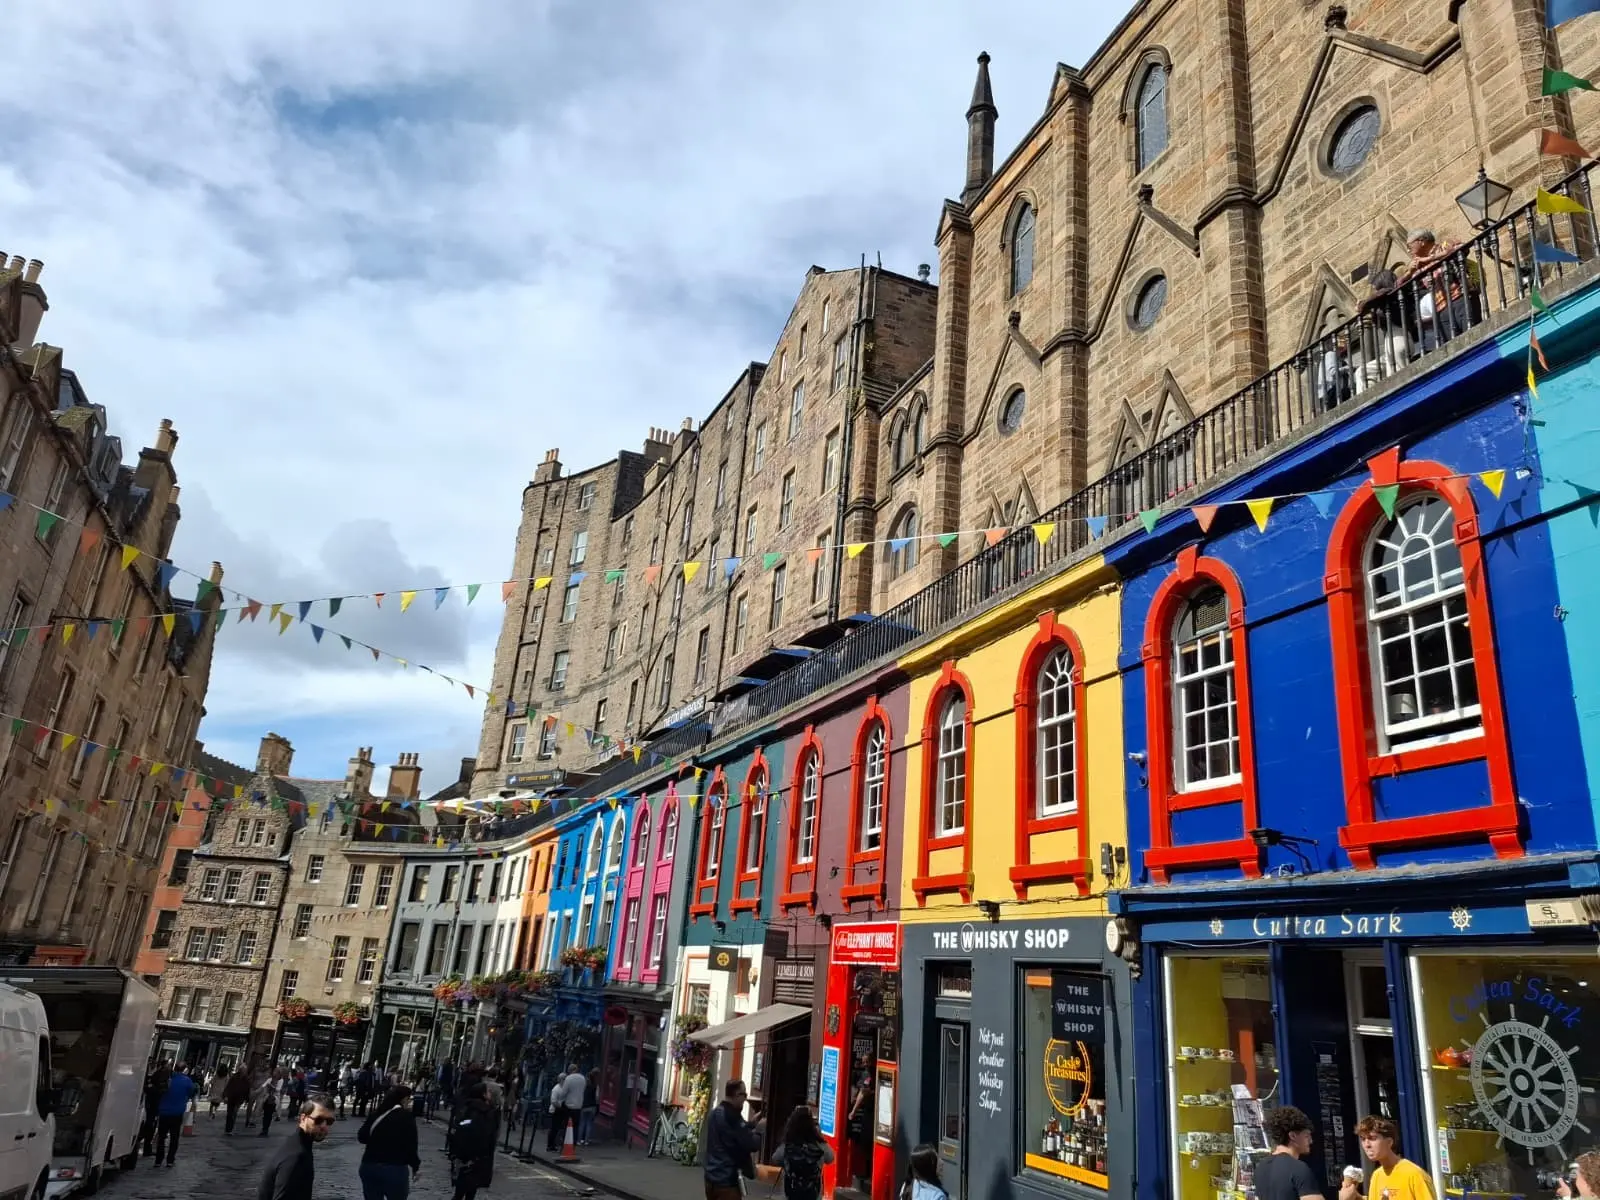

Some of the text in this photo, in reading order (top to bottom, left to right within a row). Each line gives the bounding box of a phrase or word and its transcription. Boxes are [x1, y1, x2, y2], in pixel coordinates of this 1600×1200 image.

[1253, 907, 1402, 936] Cuttea Sark
[847, 932, 875, 949] ELEPHANT
[875, 932, 895, 949] HOUSE
[933, 926, 1069, 951] THE WHISKY SHOP
[803, 965, 814, 977] SON
[1067, 985, 1089, 996] THE
[1056, 1001, 1102, 1016] WHISKY
[1524, 977, 1583, 1029] Sark
[1064, 1022, 1094, 1033] SHOP
[979, 1028, 990, 1045] Not
[979, 1051, 1005, 1068] Another
[1049, 1063, 1086, 1082] Treasures
[979, 1070, 1004, 1097] Whisky
